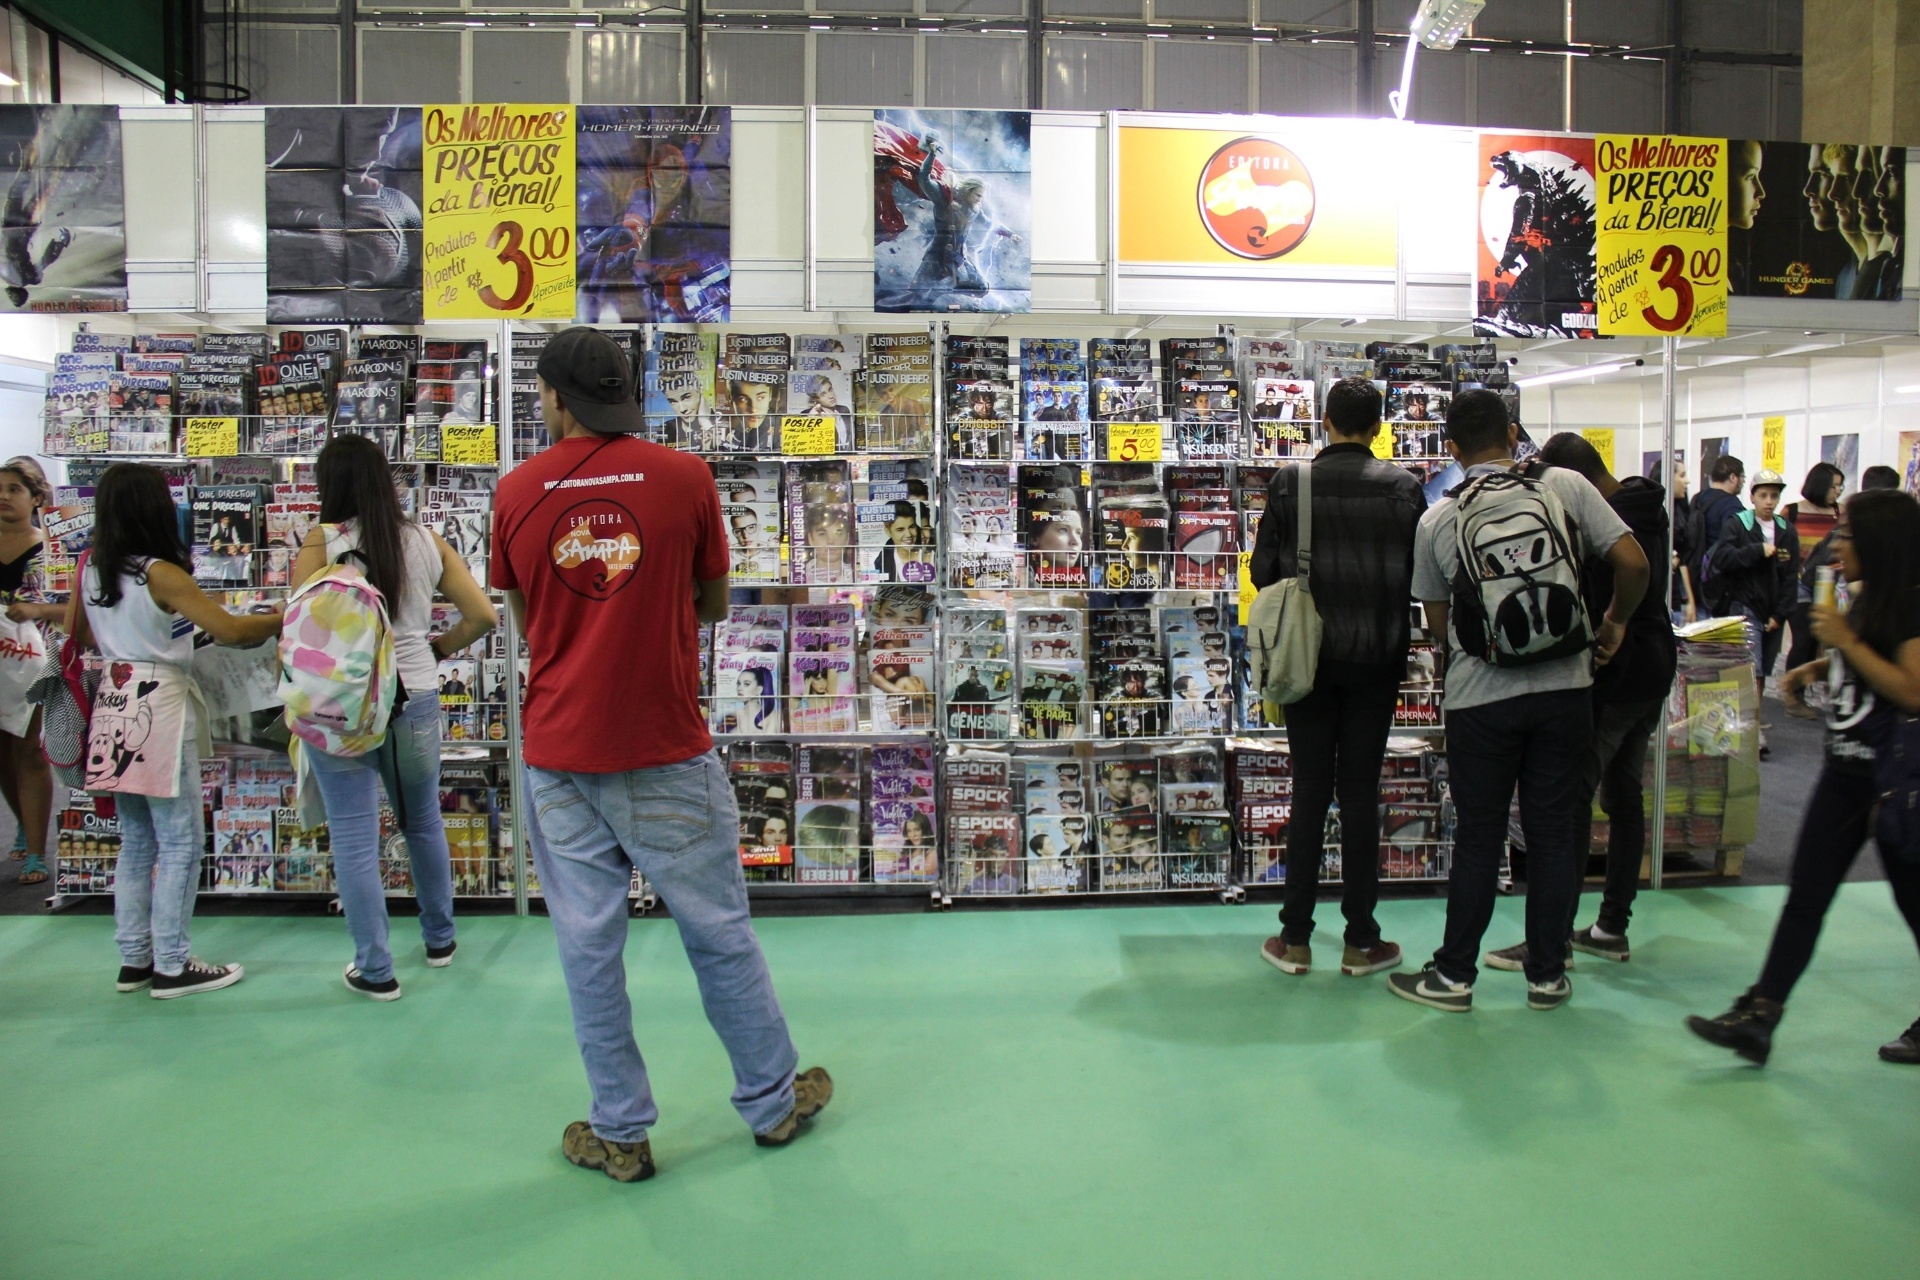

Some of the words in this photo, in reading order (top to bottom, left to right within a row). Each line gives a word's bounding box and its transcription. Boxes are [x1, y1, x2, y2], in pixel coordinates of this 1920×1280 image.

[425, 109, 454, 145] Os
[456, 106, 567, 142] Melhores
[582, 124, 720, 132] HOMEM-ARANHA
[1598, 140, 1628, 173] Os
[1629, 138, 1718, 170] Melhores
[435, 143, 561, 183] PREÇOS
[1229, 155, 1290, 171] EDITORA
[1608, 169, 1714, 204] PREÇOS
[429, 189, 461, 214] da
[1604, 213, 1631, 231] da
[425, 230, 477, 264] Produtos
[434, 257, 466, 284] partir
[1609, 269, 1639, 305] partir
[1759, 276, 1799, 284] HUNGER
[1801, 277, 1834, 285] GAMES
[437, 286, 458, 308] de
[1609, 302, 1629, 325] de
[305, 334, 336, 347] ONE
[361, 339, 408, 350] MAROON
[409, 340, 417, 349] 5
[728, 336, 756, 348] JUSTIN
[758, 336, 786, 347] BIEBER
[871, 336, 897, 347] JUSTIN
[900, 336, 928, 346] BIEBER
[729, 354, 756, 365] JUSTIN
[758, 355, 787, 365] BIEBER
[279, 363, 313, 378] ONE
[347, 363, 395, 376] MAROON
[395, 361, 403, 372] 5
[718, 370, 747, 383] JUSTIN
[749, 372, 780, 385] BIEBER
[869, 373, 898, 384] JUSTIN
[899, 373, 930, 384] BIEBER
[340, 387, 388, 398] MAROON
[389, 386, 397, 397] 5
[784, 418, 824, 428] POSTER
[1279, 429, 1306, 442] PAPEL
[440, 467, 466, 478] DEMI
[873, 472, 905, 480] BIEBER
[217, 488, 256, 499] DIRECTION
[874, 484, 908, 493] JUSTIN
[431, 491, 458, 502] DEMI
[874, 492, 907, 500] BIEBER
[212, 500, 250, 512] DIRECTION
[860, 505, 896, 514] JUSTIN
[44, 511, 61, 526] ONE
[422, 510, 449, 523] DEMI
[570, 514, 622, 528] EDITORA
[794, 505, 804, 539] BIEBER
[861, 513, 895, 522] BIEBER
[49, 514, 89, 537] DIRECTION
[794, 540, 805, 574] JUSTIN
[731, 611, 755, 624] Katy
[758, 609, 785, 623] Perry
[796, 610, 818, 625] Katy
[820, 610, 849, 626] Perry
[727, 636, 750, 648] Katy
[753, 634, 780, 647] Perry
[794, 632, 818, 647] Katy
[821, 632, 849, 647] Perry
[873, 630, 925, 642] Rihanna
[719, 658, 743, 671] Katy
[746, 656, 774, 671] Perry
[794, 659, 819, 672] Katy
[820, 658, 849, 672] Perry
[873, 654, 925, 666] Rihanna
[1046, 710, 1073, 722] PAPEL
[1237, 755, 1288, 768] SPOCK
[947, 763, 1002, 776] SPOCK
[952, 787, 1009, 802] SPOCK
[84, 813, 116, 827] ONE
[278, 809, 296, 818] ONE
[959, 816, 1016, 830] SPOCK
[1172, 873, 1227, 884] INSURGENTE
